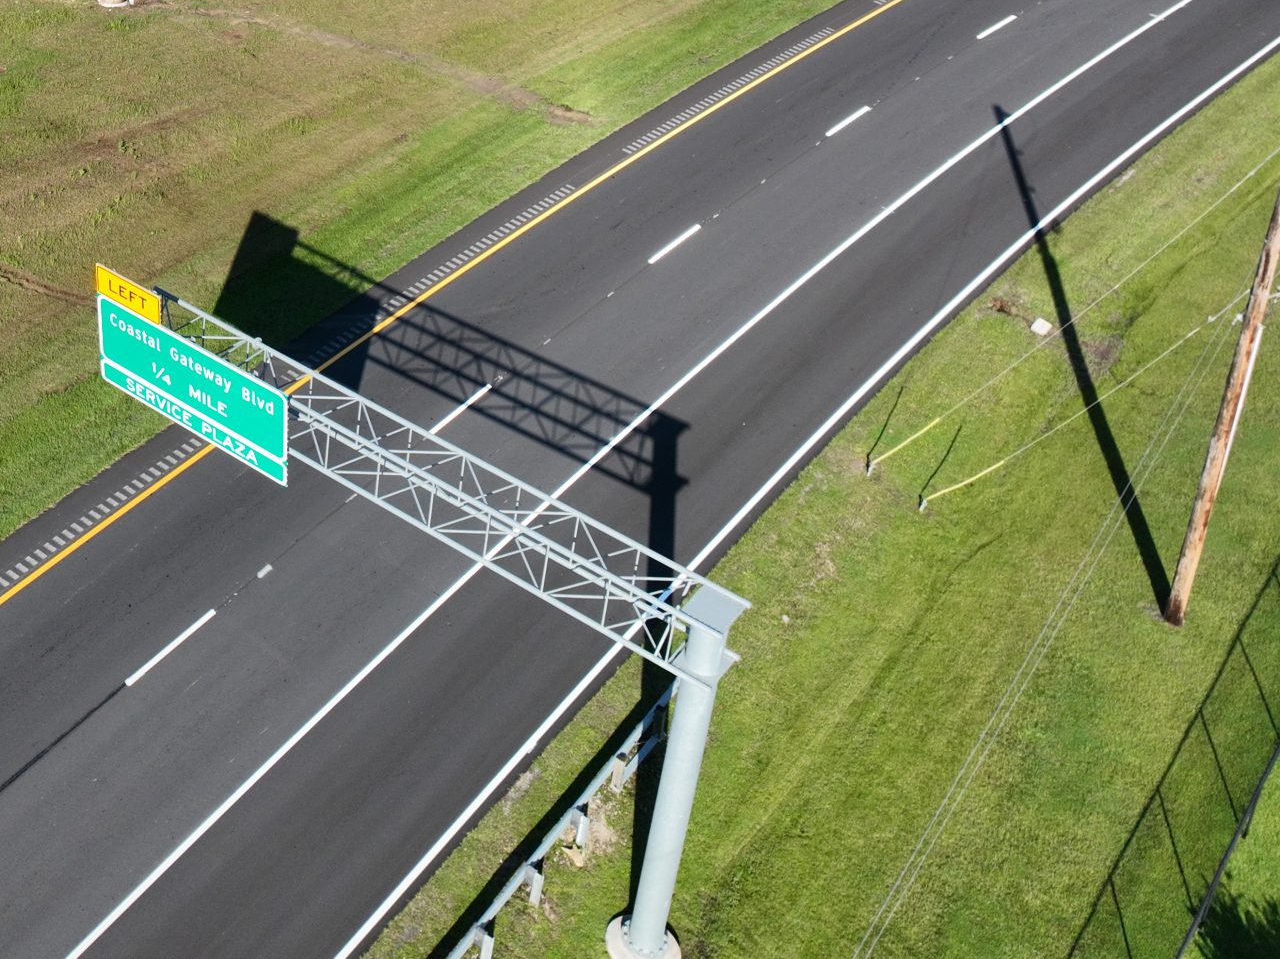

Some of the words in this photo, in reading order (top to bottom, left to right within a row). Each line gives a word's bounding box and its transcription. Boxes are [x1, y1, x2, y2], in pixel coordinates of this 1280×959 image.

[108, 279, 147, 310] LEFT
[109, 313, 161, 352] Coastal
[170, 347, 232, 393] Gateway
[241, 386, 275, 416] Blvd
[126, 377, 193, 427] SERVICE
[201, 422, 258, 465] PLAZA
[188, 385, 228, 417] MILE
